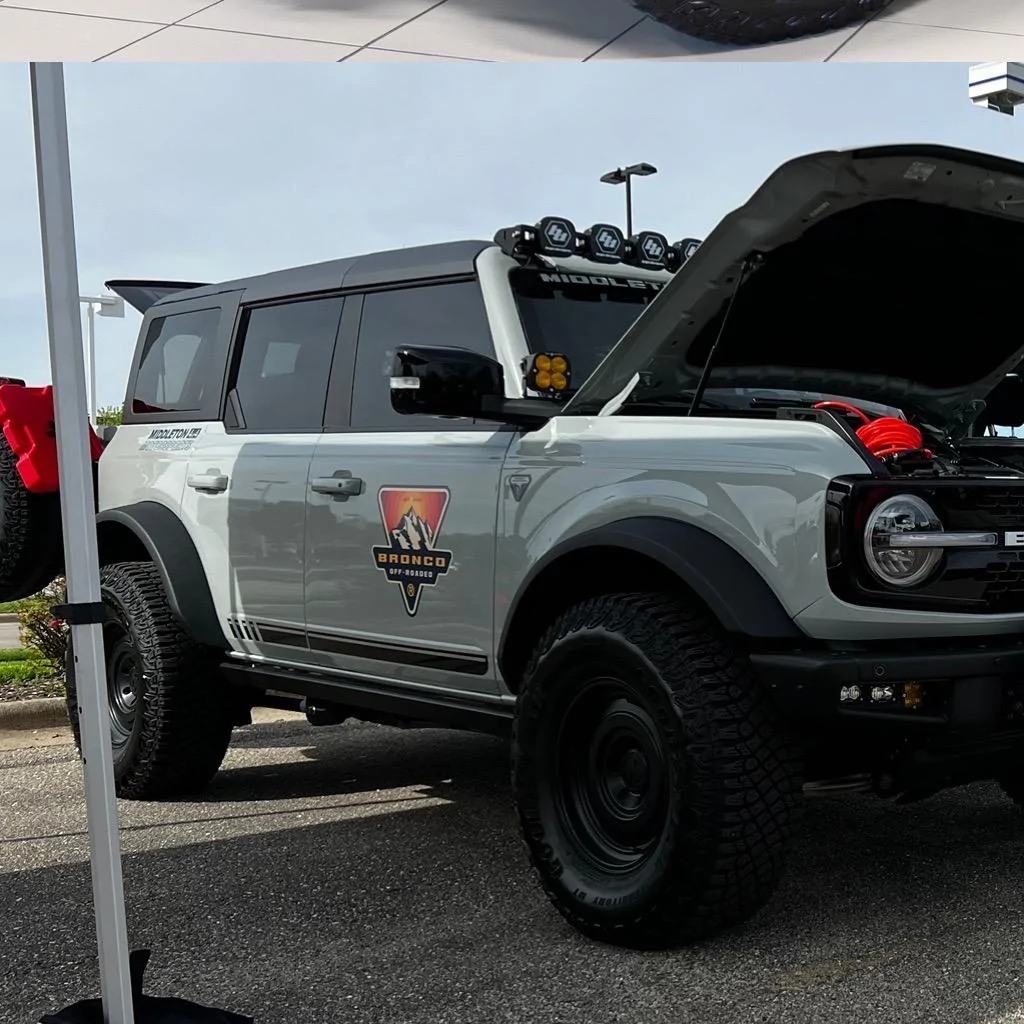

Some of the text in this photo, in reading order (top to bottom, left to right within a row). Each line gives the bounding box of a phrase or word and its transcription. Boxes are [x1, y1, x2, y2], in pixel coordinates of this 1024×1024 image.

[540, 273, 667, 291] MIDDLET
[378, 553, 446, 567] BRONCO
[389, 568, 433, 578] OFF-ROADEO
